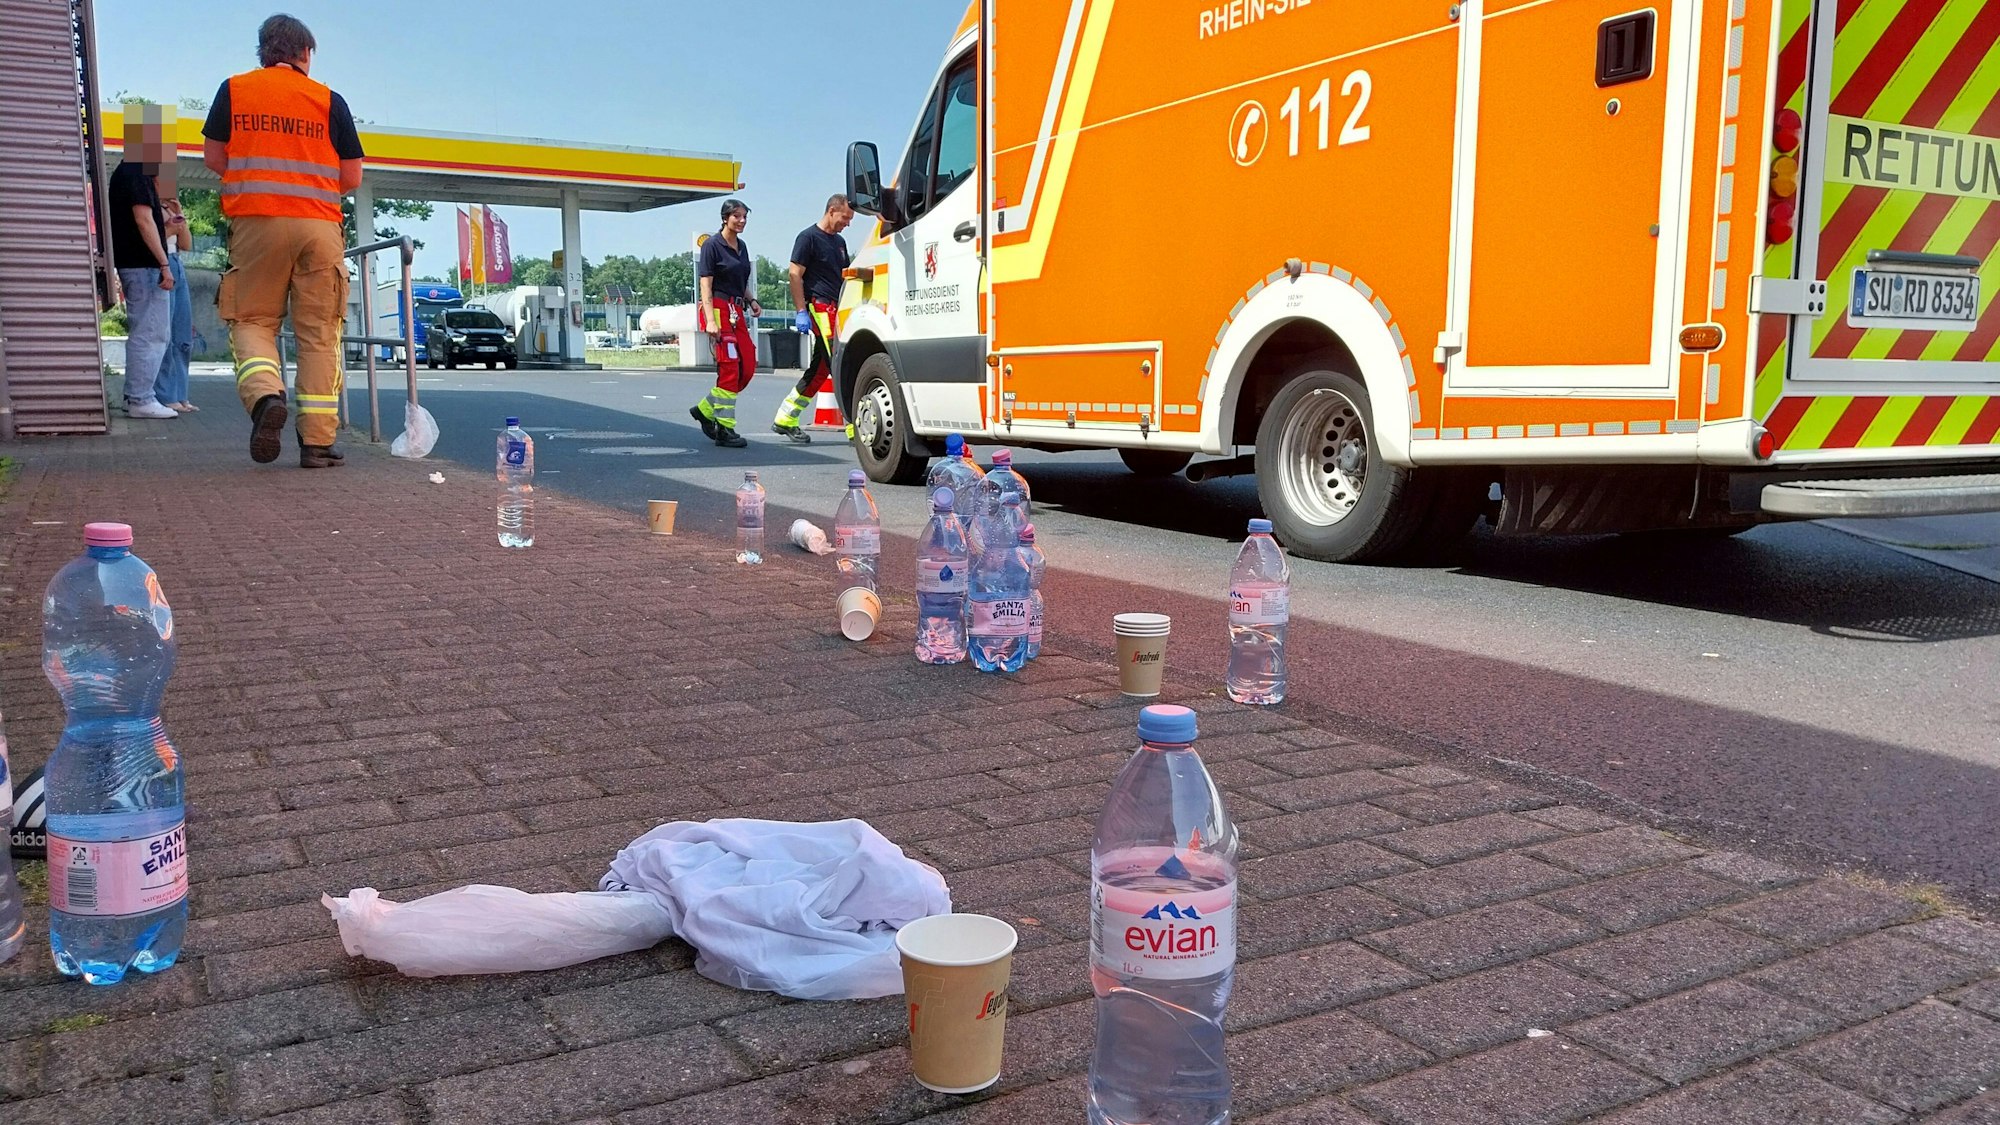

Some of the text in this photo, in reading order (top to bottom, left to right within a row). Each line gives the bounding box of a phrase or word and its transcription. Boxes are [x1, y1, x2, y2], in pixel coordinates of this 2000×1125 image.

[1279, 69, 1372, 157] 112
[233, 114, 325, 140] FEUERWEHR
[1843, 123, 2000, 195] RETTUN
[494, 226, 504, 271] Serways
[905, 284, 960, 301] RETTUNGSDIENST
[1868, 277, 1893, 311] SU
[1904, 279, 1929, 313] RD
[1932, 280, 1974, 315] 8334
[905, 300, 961, 317] RHEIN-SIEG-KREIS
[992, 609, 1026, 619] EMILIA
[995, 601, 1024, 611] SANTA
[1131, 650, 1160, 663] Segafredo
[10, 831, 46, 847] dida
[142, 844, 185, 876] EMIL
[1124, 923, 1216, 953] evian
[1143, 953, 1171, 961] NATURAL
[1199, 950, 1216, 958] WATER
